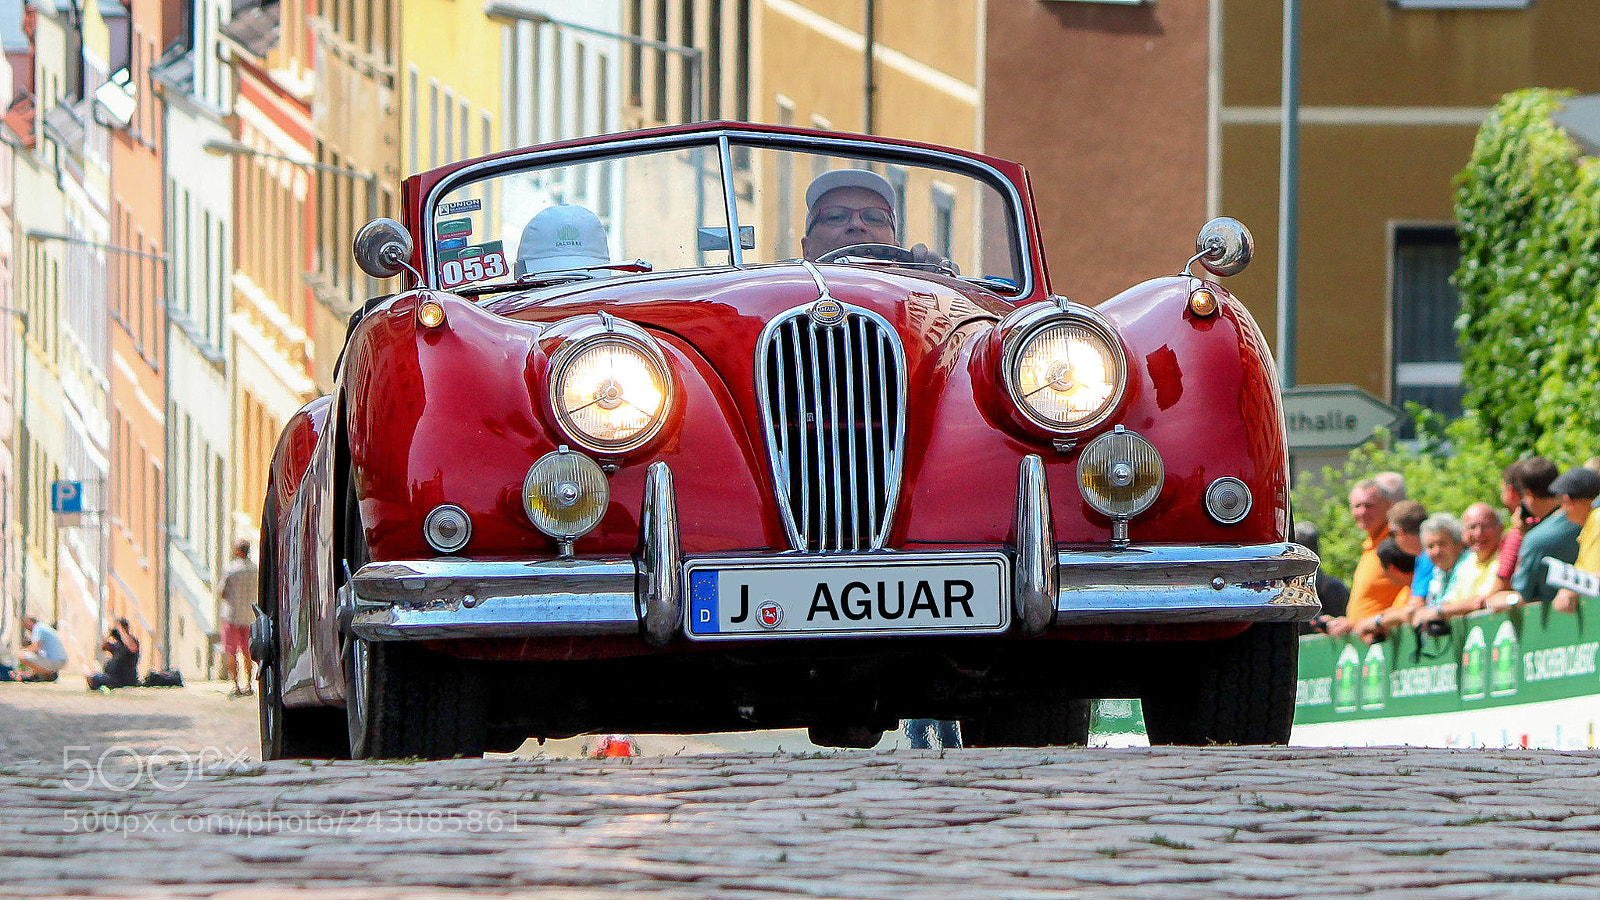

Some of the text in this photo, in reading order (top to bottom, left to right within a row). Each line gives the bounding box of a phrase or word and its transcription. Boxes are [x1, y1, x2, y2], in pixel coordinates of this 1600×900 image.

[450, 199, 480, 208] UNION
[443, 253, 504, 285] 053
[57, 483, 77, 511] P
[700, 609, 710, 622] D
[730, 579, 975, 624] J AGUAR
